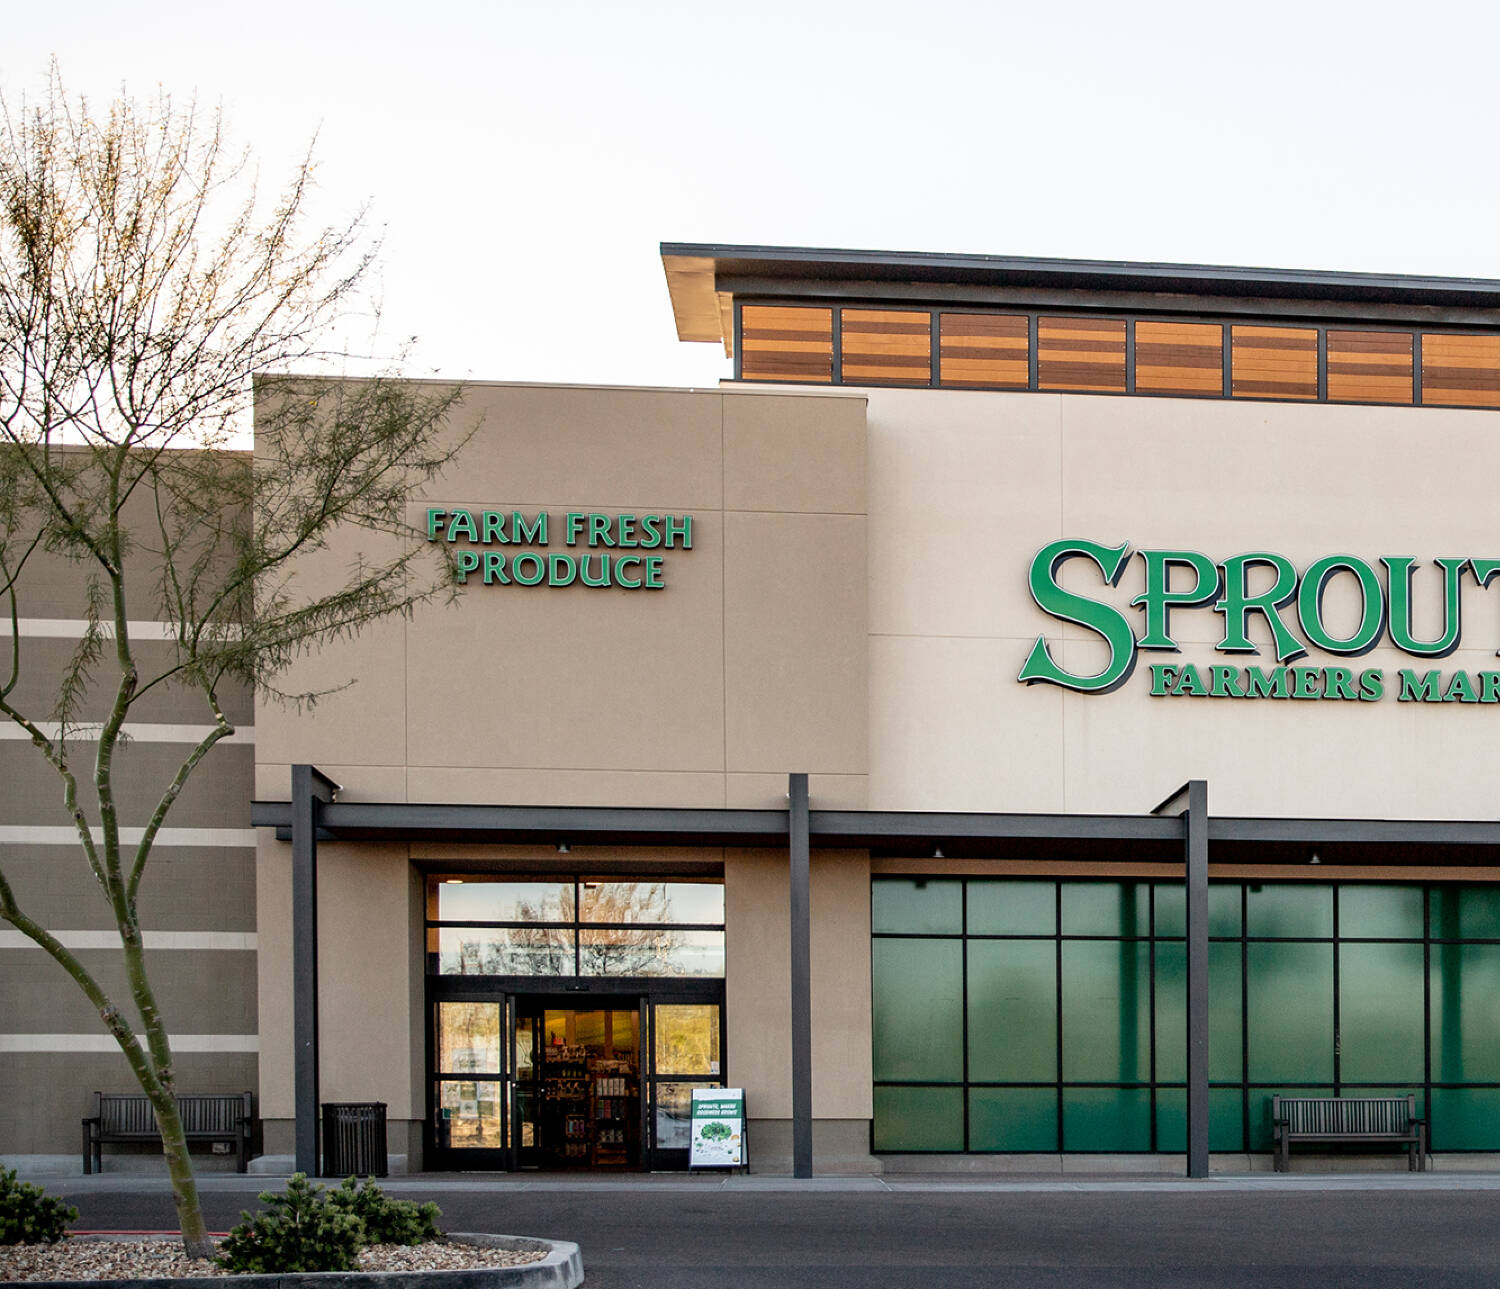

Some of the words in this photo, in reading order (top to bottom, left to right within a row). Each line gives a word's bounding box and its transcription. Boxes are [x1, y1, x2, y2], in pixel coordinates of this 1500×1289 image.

[426, 508, 549, 546] FARM
[566, 512, 694, 550] FRESH
[456, 550, 665, 590] PRODUCE
[1149, 663, 1384, 702] FARMERS
